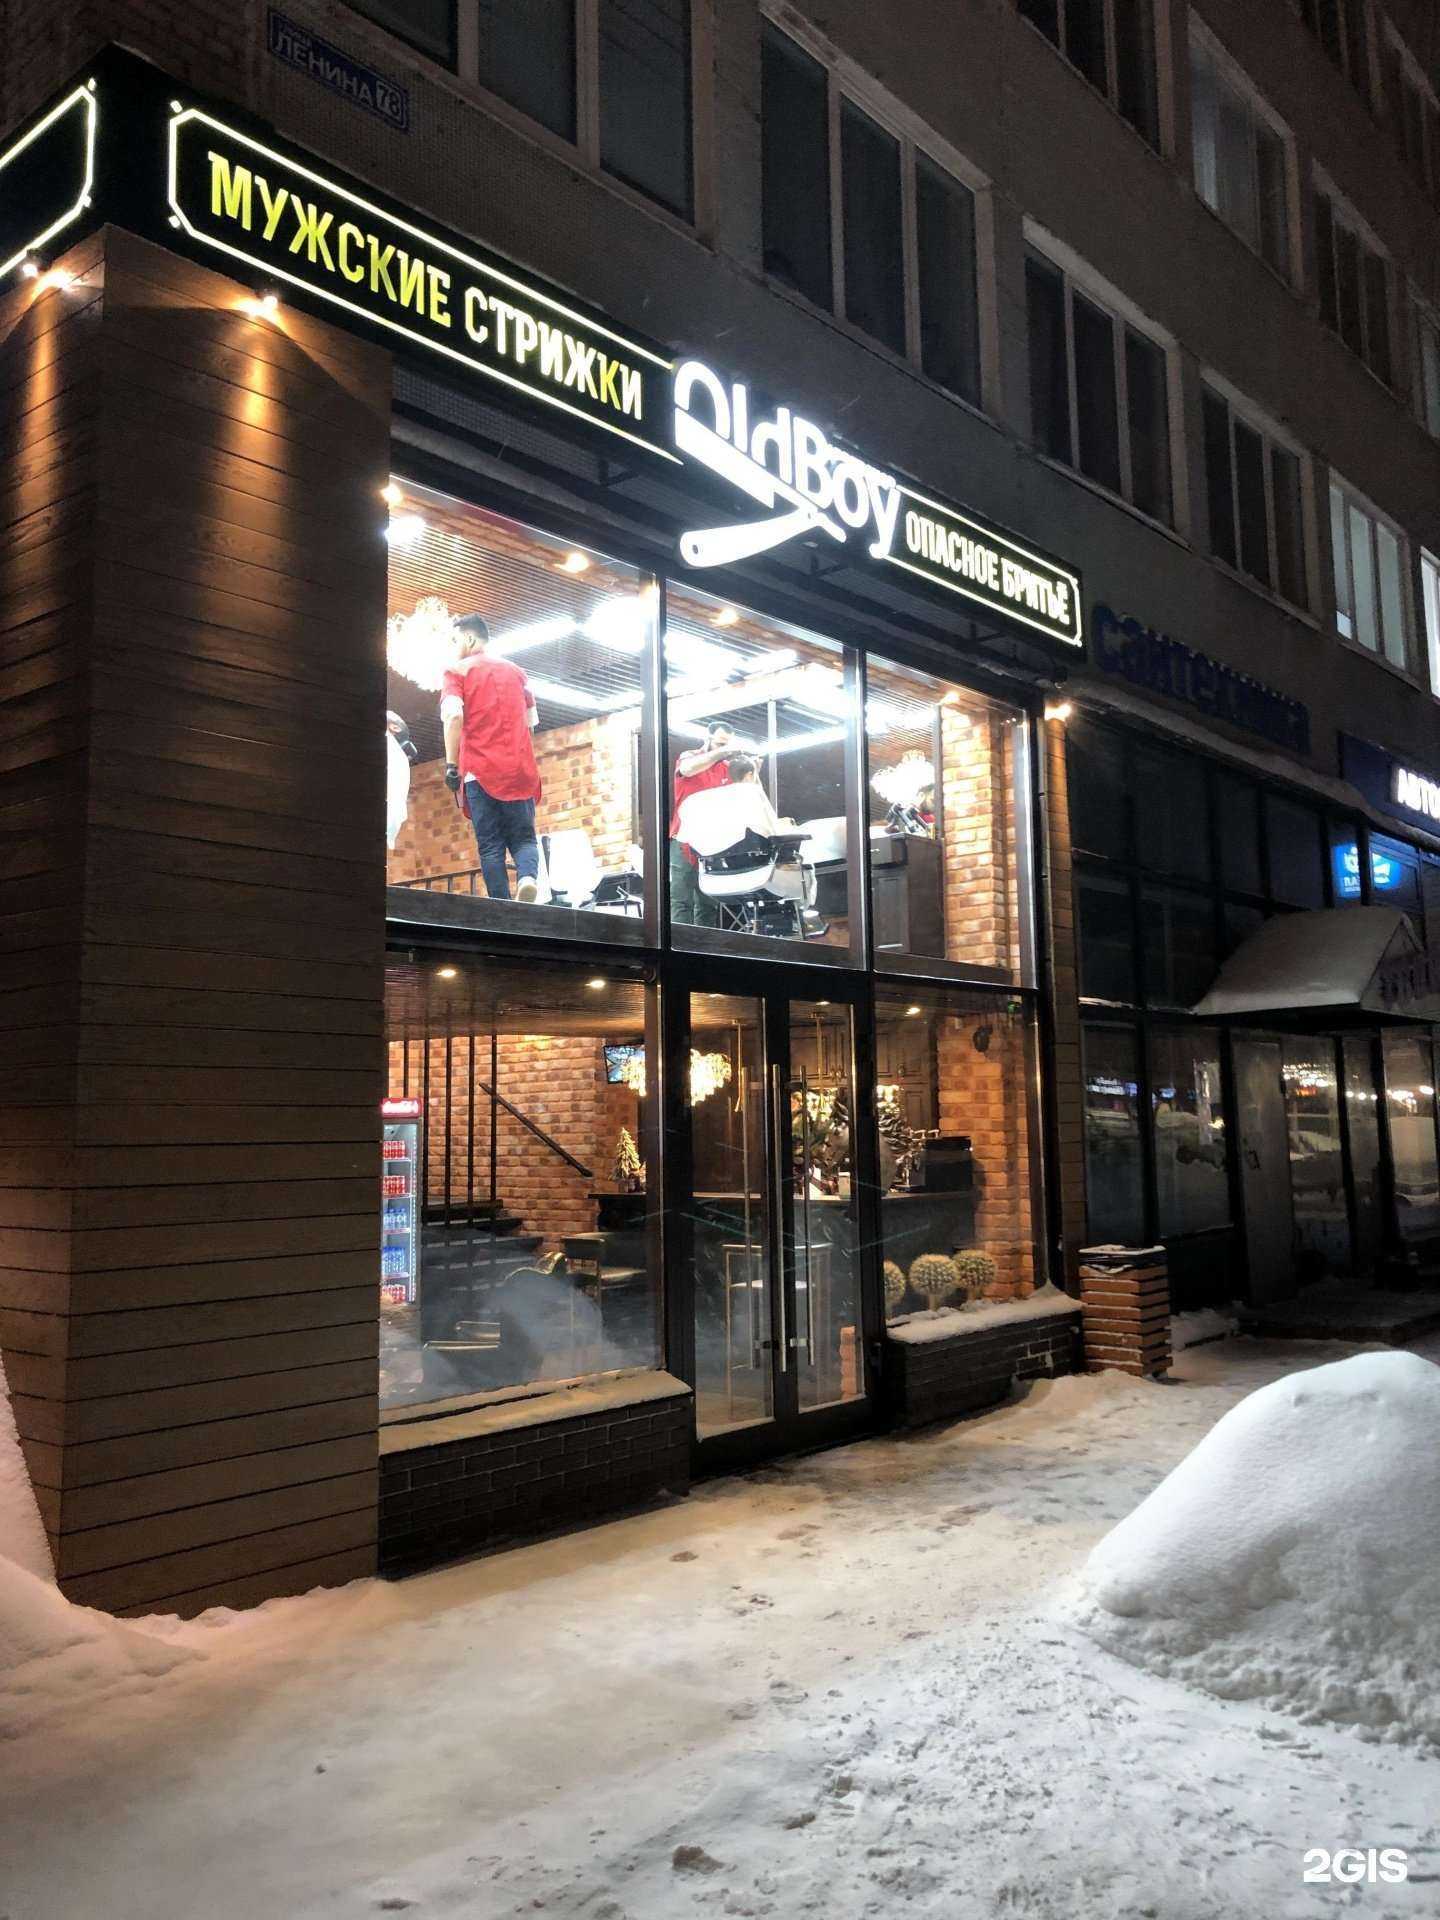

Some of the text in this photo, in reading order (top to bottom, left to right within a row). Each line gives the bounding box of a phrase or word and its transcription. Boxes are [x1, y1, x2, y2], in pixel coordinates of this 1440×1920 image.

[274, 33, 374, 107] ЛЕНИНА
[207, 150, 643, 421] МУЖСКИЕ СТРИЖКИ
[673, 360, 902, 560] OldBoy
[905, 510, 1000, 591] ОПАСНОЕ
